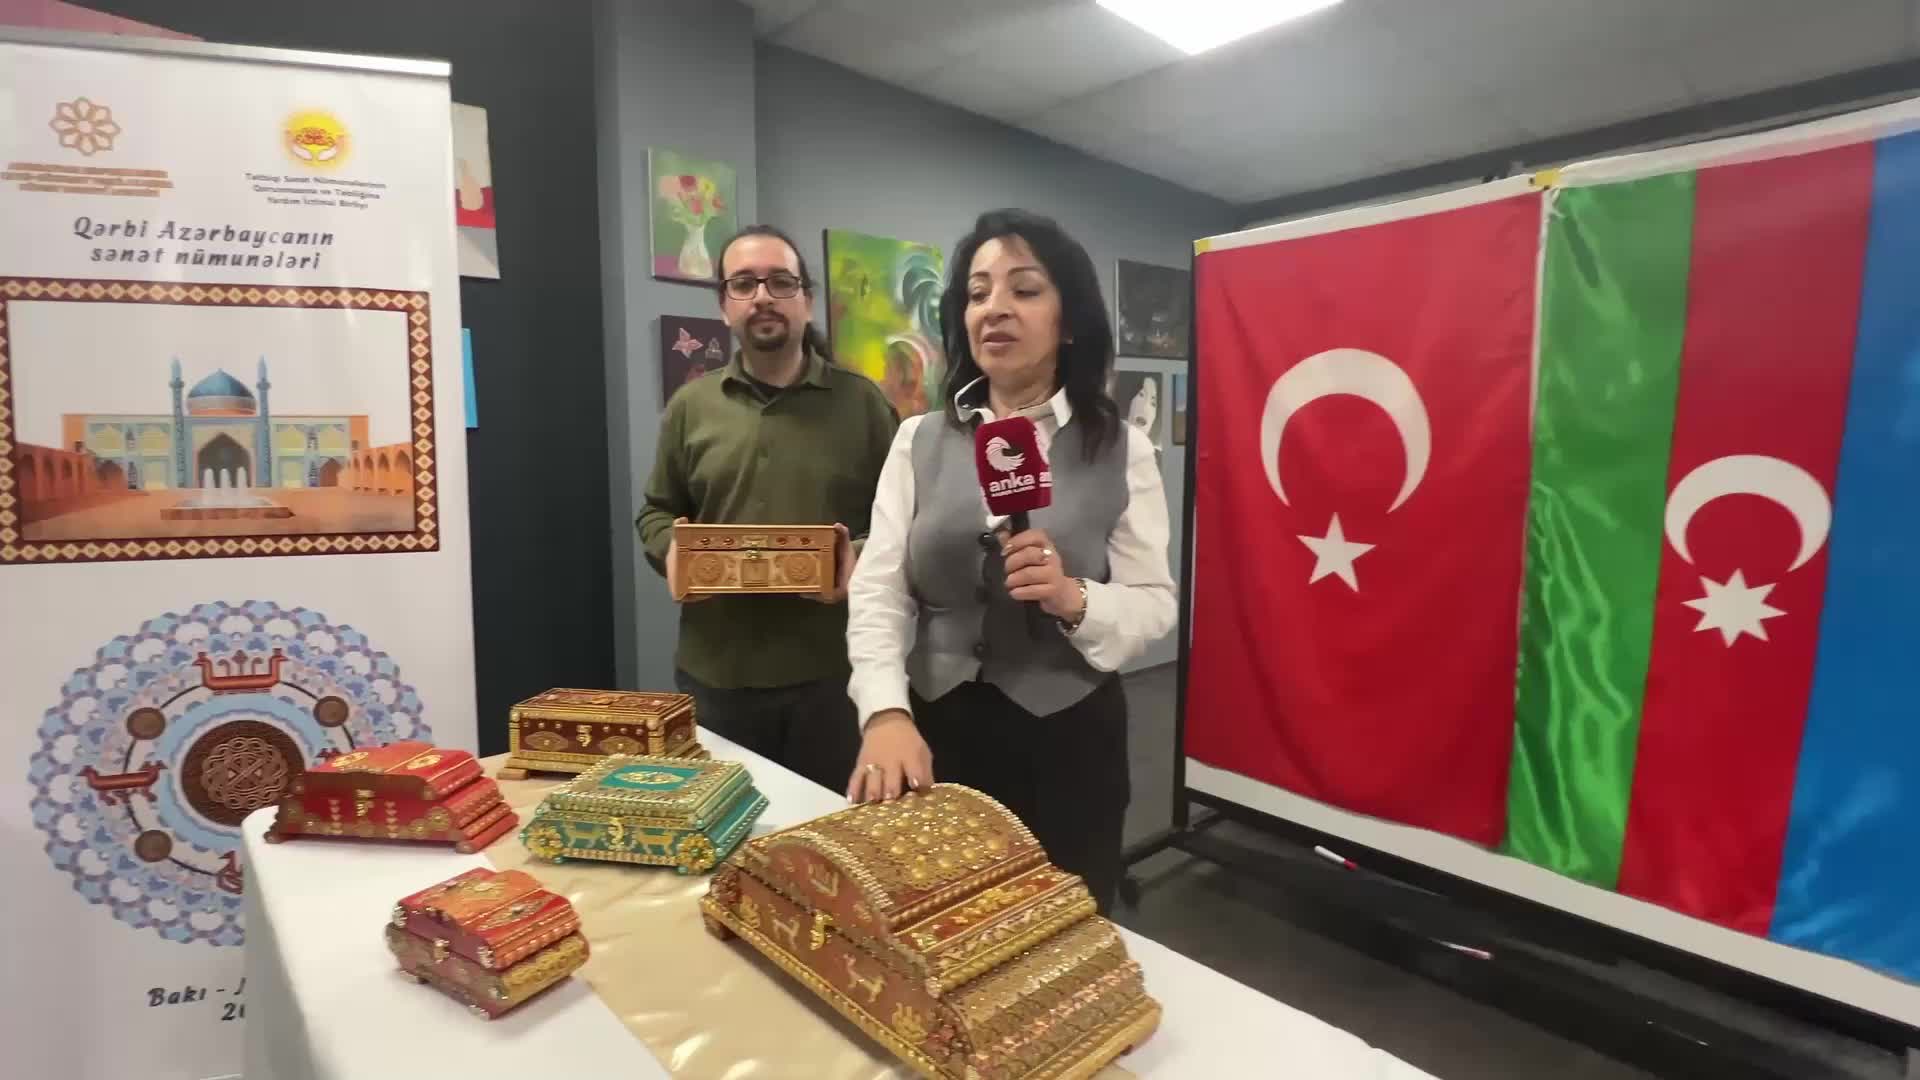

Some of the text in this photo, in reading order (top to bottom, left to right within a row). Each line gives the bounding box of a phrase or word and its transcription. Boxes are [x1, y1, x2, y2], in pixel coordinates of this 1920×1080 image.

[74, 216, 333, 248] Qərbi Azərbaycanın
[90, 247, 320, 270] sənət nümunələri
[989, 472, 1035, 492] anka
[147, 986, 207, 1007] Bakı
